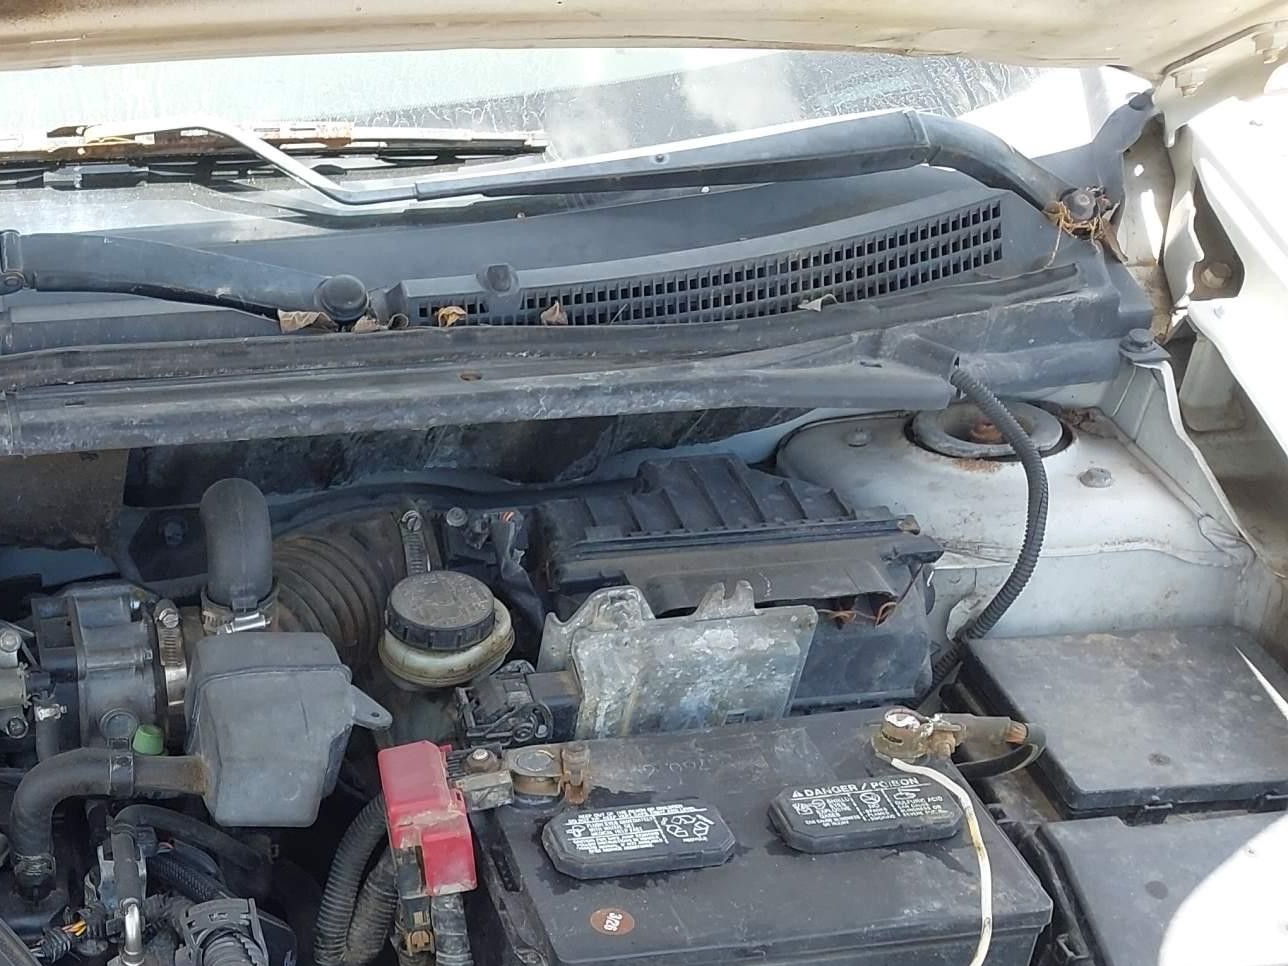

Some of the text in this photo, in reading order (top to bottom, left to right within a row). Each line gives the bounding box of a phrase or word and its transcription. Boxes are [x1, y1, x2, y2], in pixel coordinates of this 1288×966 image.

[804, 784, 858, 796] DANGER
[870, 777, 920, 789] POISON
[603, 912, 623, 932] 3/26
